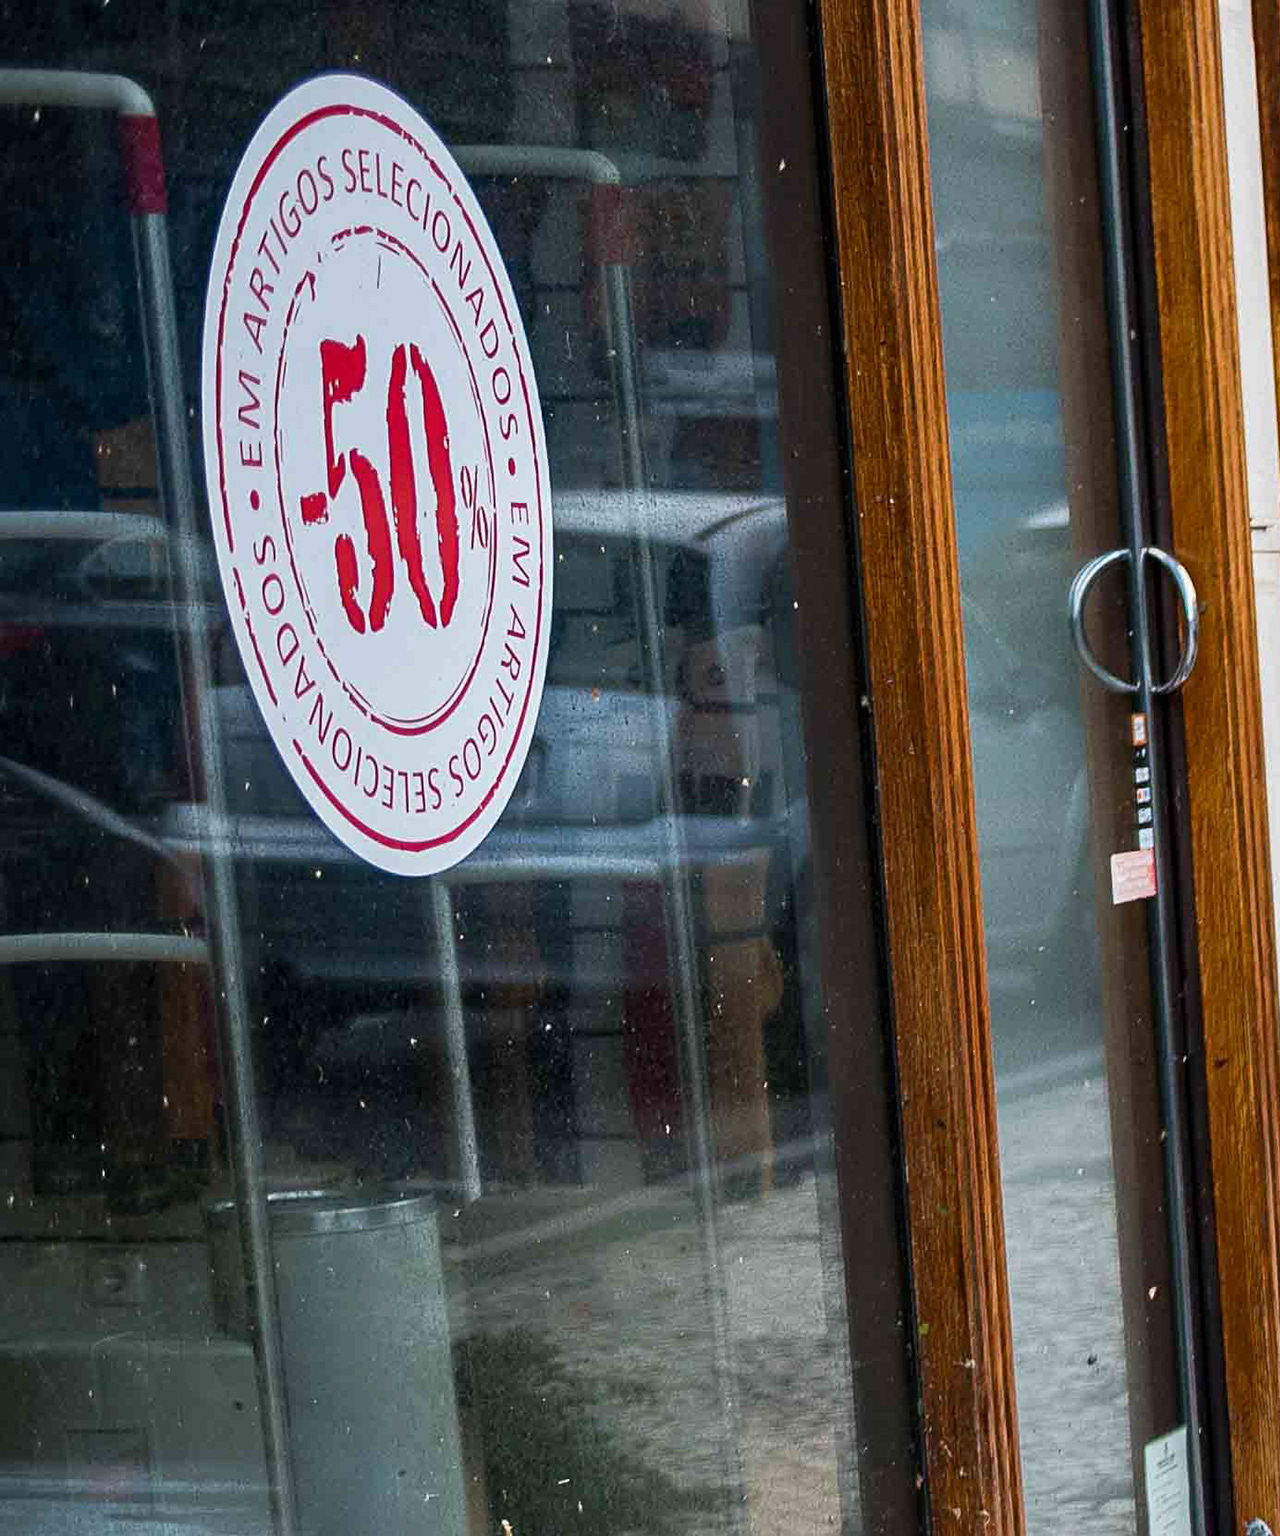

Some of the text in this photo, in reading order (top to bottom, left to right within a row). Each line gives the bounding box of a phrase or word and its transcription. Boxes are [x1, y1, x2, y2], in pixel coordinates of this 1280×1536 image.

[237, 147, 519, 467] EM ARTIGOS SELECIONADOS
[253, 501, 531, 814] EM ARTIGOS SELECIONADOS
